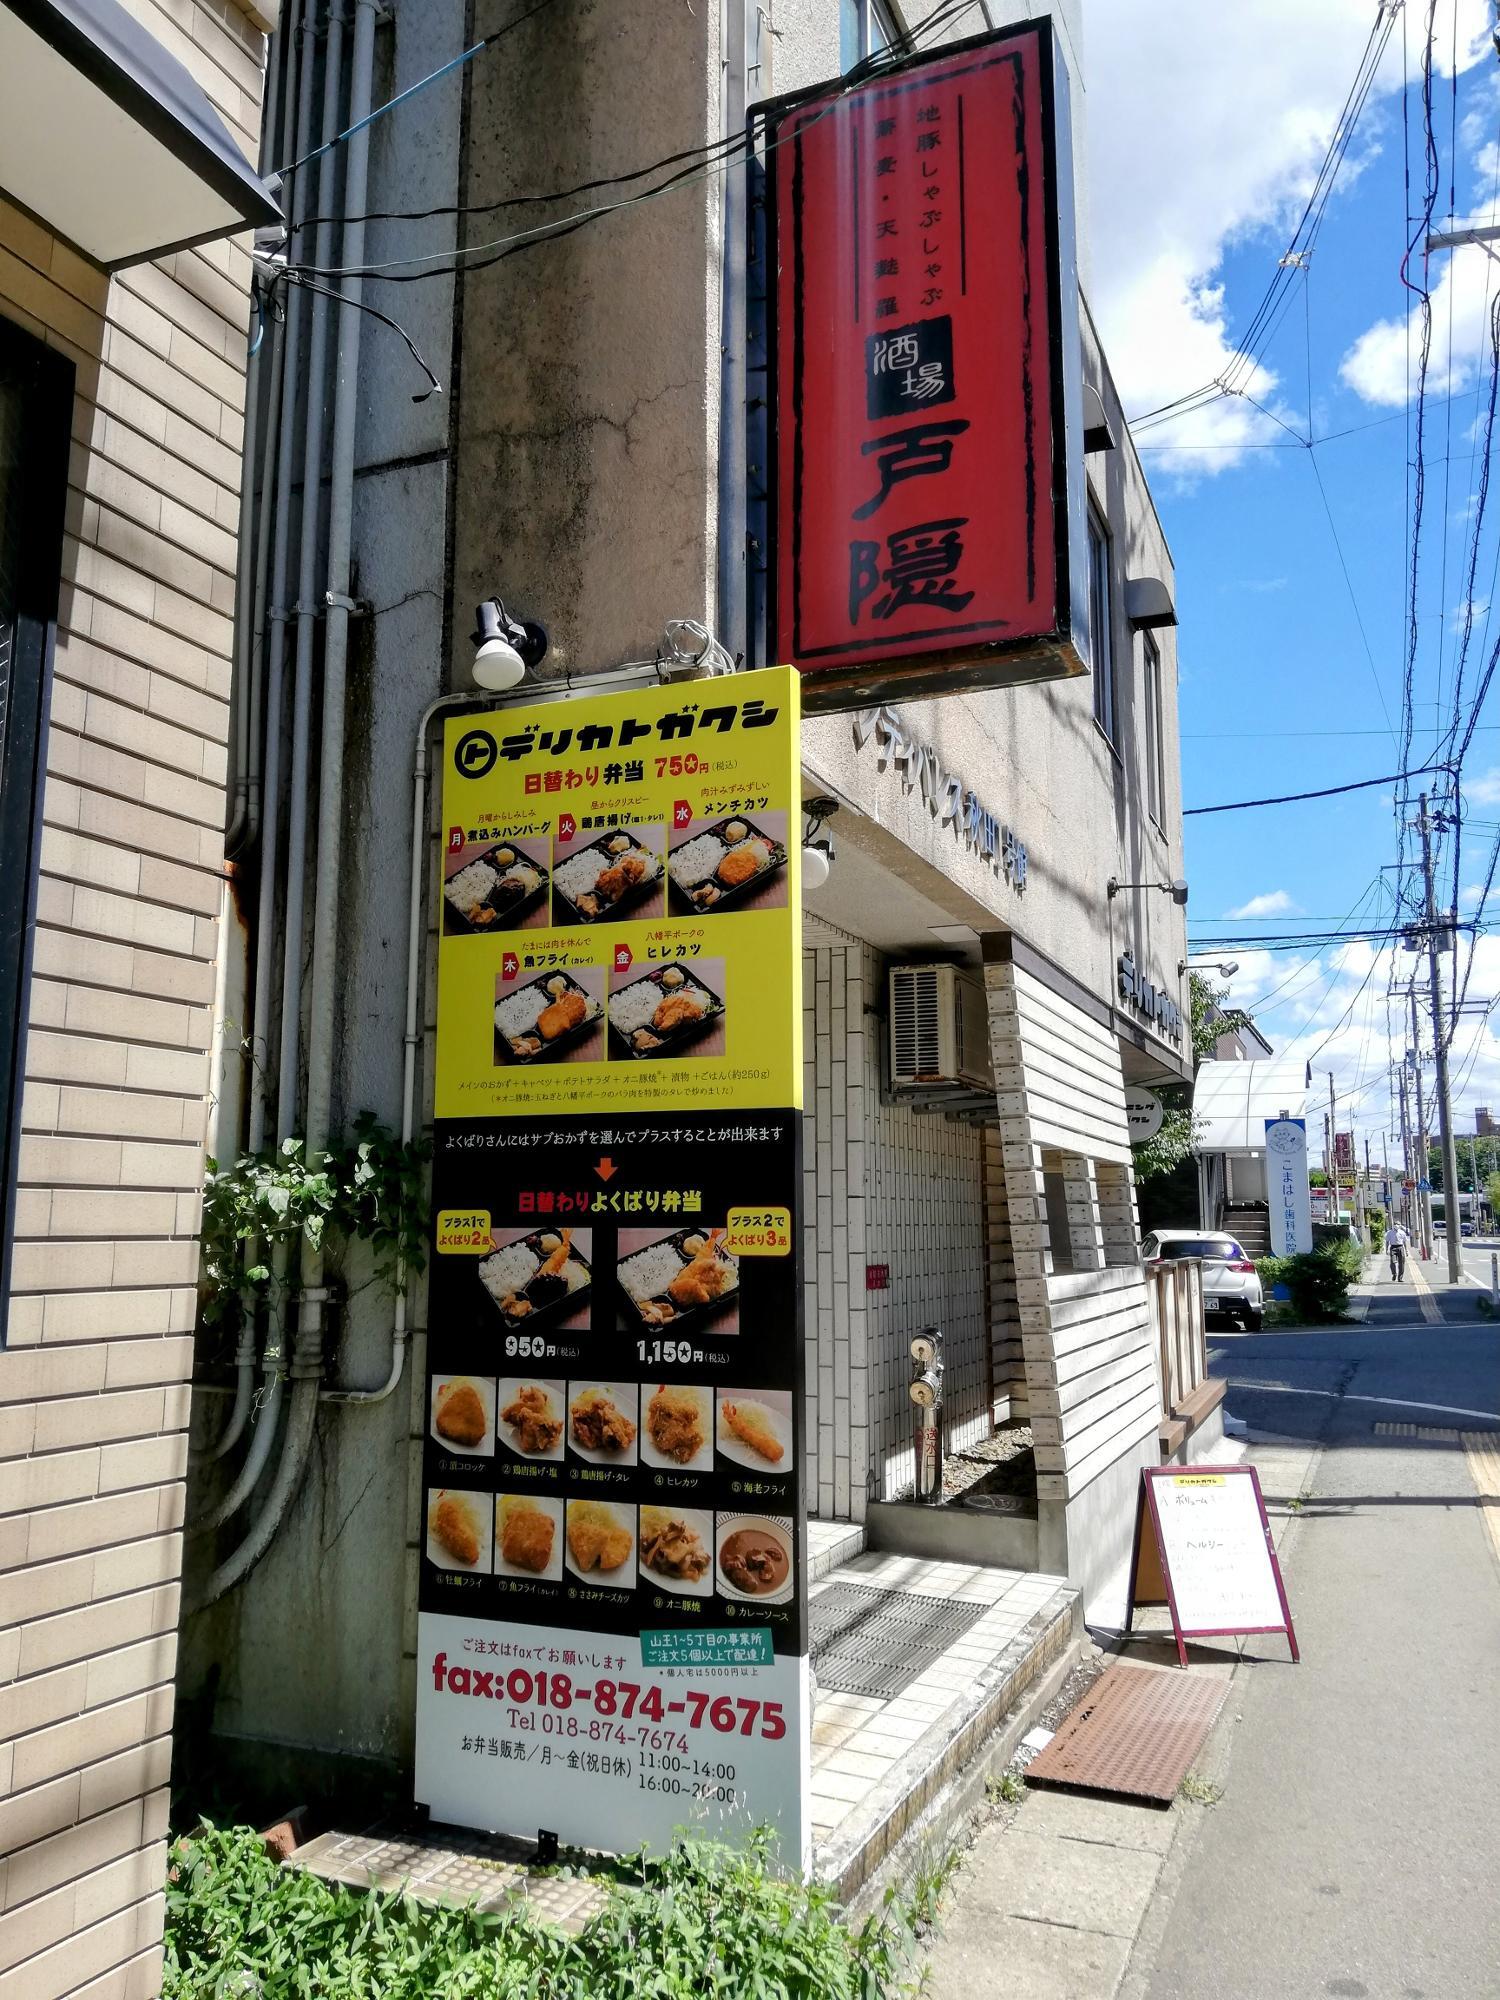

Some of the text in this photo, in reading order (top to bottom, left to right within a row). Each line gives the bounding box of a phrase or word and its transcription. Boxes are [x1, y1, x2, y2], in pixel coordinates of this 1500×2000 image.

[916, 105, 943, 307] 地豚しゃぶしゃぶ
[873, 333, 945, 400] 酒場
[849, 419, 975, 625] 戸隠
[500, 700, 779, 761] デリカトガクシ
[524, 759, 644, 795] 日替わり弁当
[701, 781, 770, 798] 肉汁みずみずしい
[477, 809, 537, 824] 月曜からしみしみ
[676, 797, 769, 820] 水 メンチカツ
[451, 821, 551, 846] 月 煮込みハンバーグ
[561, 821, 573, 834] 火
[521, 937, 592, 951] たまには肉を休んで
[645, 929, 705, 942] 八幡平ポークの
[615, 943, 702, 966] 金 ヒレカツ
[504, 960, 516, 973] 木
[444, 1126, 783, 1149] よくばりさんにはサブおかずを選んでプラスすることが出来ます
[518, 1190, 702, 1213] 日替わりよくばり弁当
[1282, 1160, 1297, 1253] こまはし歯科医院
[444, 1216, 485, 1229] プラス1で
[731, 1213, 785, 1229] プラス2で
[438, 1231, 490, 1247] よくばり2品
[727, 1231, 788, 1247] よくばり3品
[926, 1427, 937, 1467] 送水口
[667, 1477, 698, 1488] ヒレカツ
[744, 1483, 786, 1496] 海老フライ
[738, 1607, 789, 1622] カレーソース
[462, 1637, 627, 1672] ご注文はfaxでお願いします
[433, 1653, 786, 1740] fax:018-874-7675
[506, 1709, 689, 1754] Tel 018-874-7674
[639, 1751, 735, 1780] 11:00~14:00
